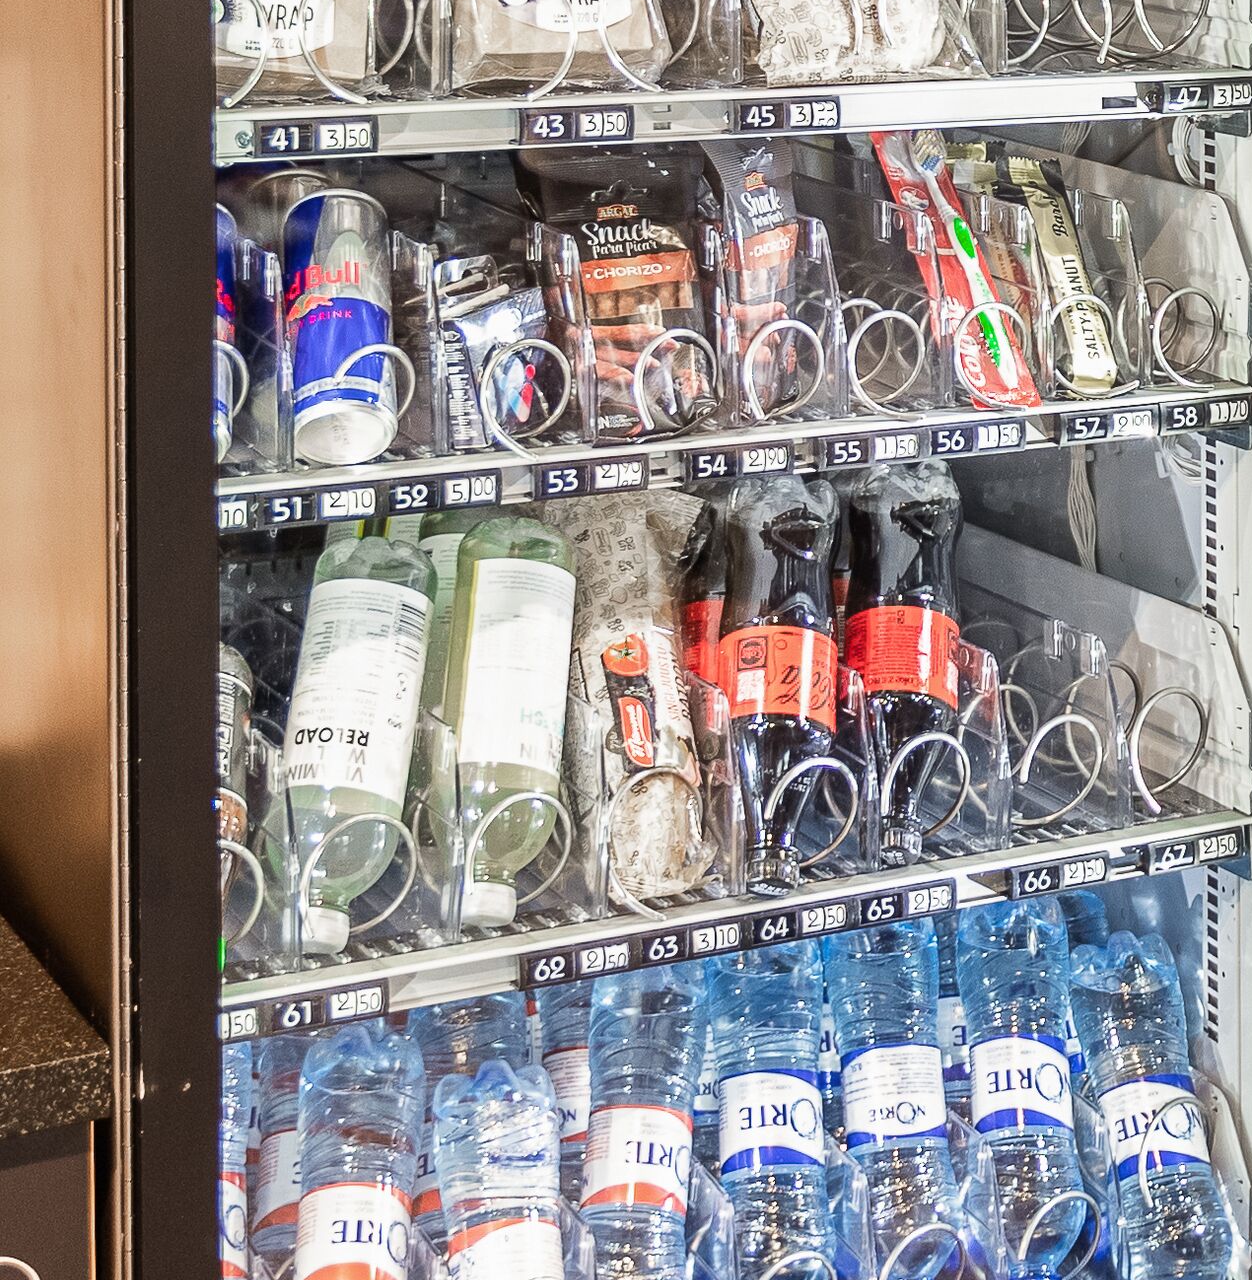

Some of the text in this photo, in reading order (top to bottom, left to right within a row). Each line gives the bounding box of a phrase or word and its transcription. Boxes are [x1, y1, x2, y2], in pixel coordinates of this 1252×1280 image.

[1175, 87, 1202, 107] 47
[532, 113, 628, 138] 43 3.50
[745, 105, 776, 128] 45
[269, 126, 370, 152] 41 3.50
[740, 186, 785, 218] Snack
[580, 218, 658, 247] Snack
[304, 260, 361, 290] Bull
[592, 263, 664, 281] CHORIZO
[1061, 256, 1088, 312] PANUT
[1172, 402, 1249, 428] 58 1.70
[1074, 417, 1101, 439] 57
[833, 440, 863, 464] 55
[937, 429, 966, 453] 56
[697, 455, 728, 478] 54
[394, 477, 495, 509] 52 5.00
[547, 470, 580, 494] 53
[270, 496, 303, 522] 51
[293, 727, 371, 747] RELOAD
[1162, 844, 1189, 865] 67
[1024, 870, 1052, 892] 66
[867, 899, 895, 921] 65
[760, 918, 790, 941] 64
[647, 936, 679, 960] 63
[533, 955, 566, 981] 62
[281, 1004, 312, 1028] 61
[739, 1097, 821, 1139] ORTE
[868, 1101, 927, 1125] NORTE
